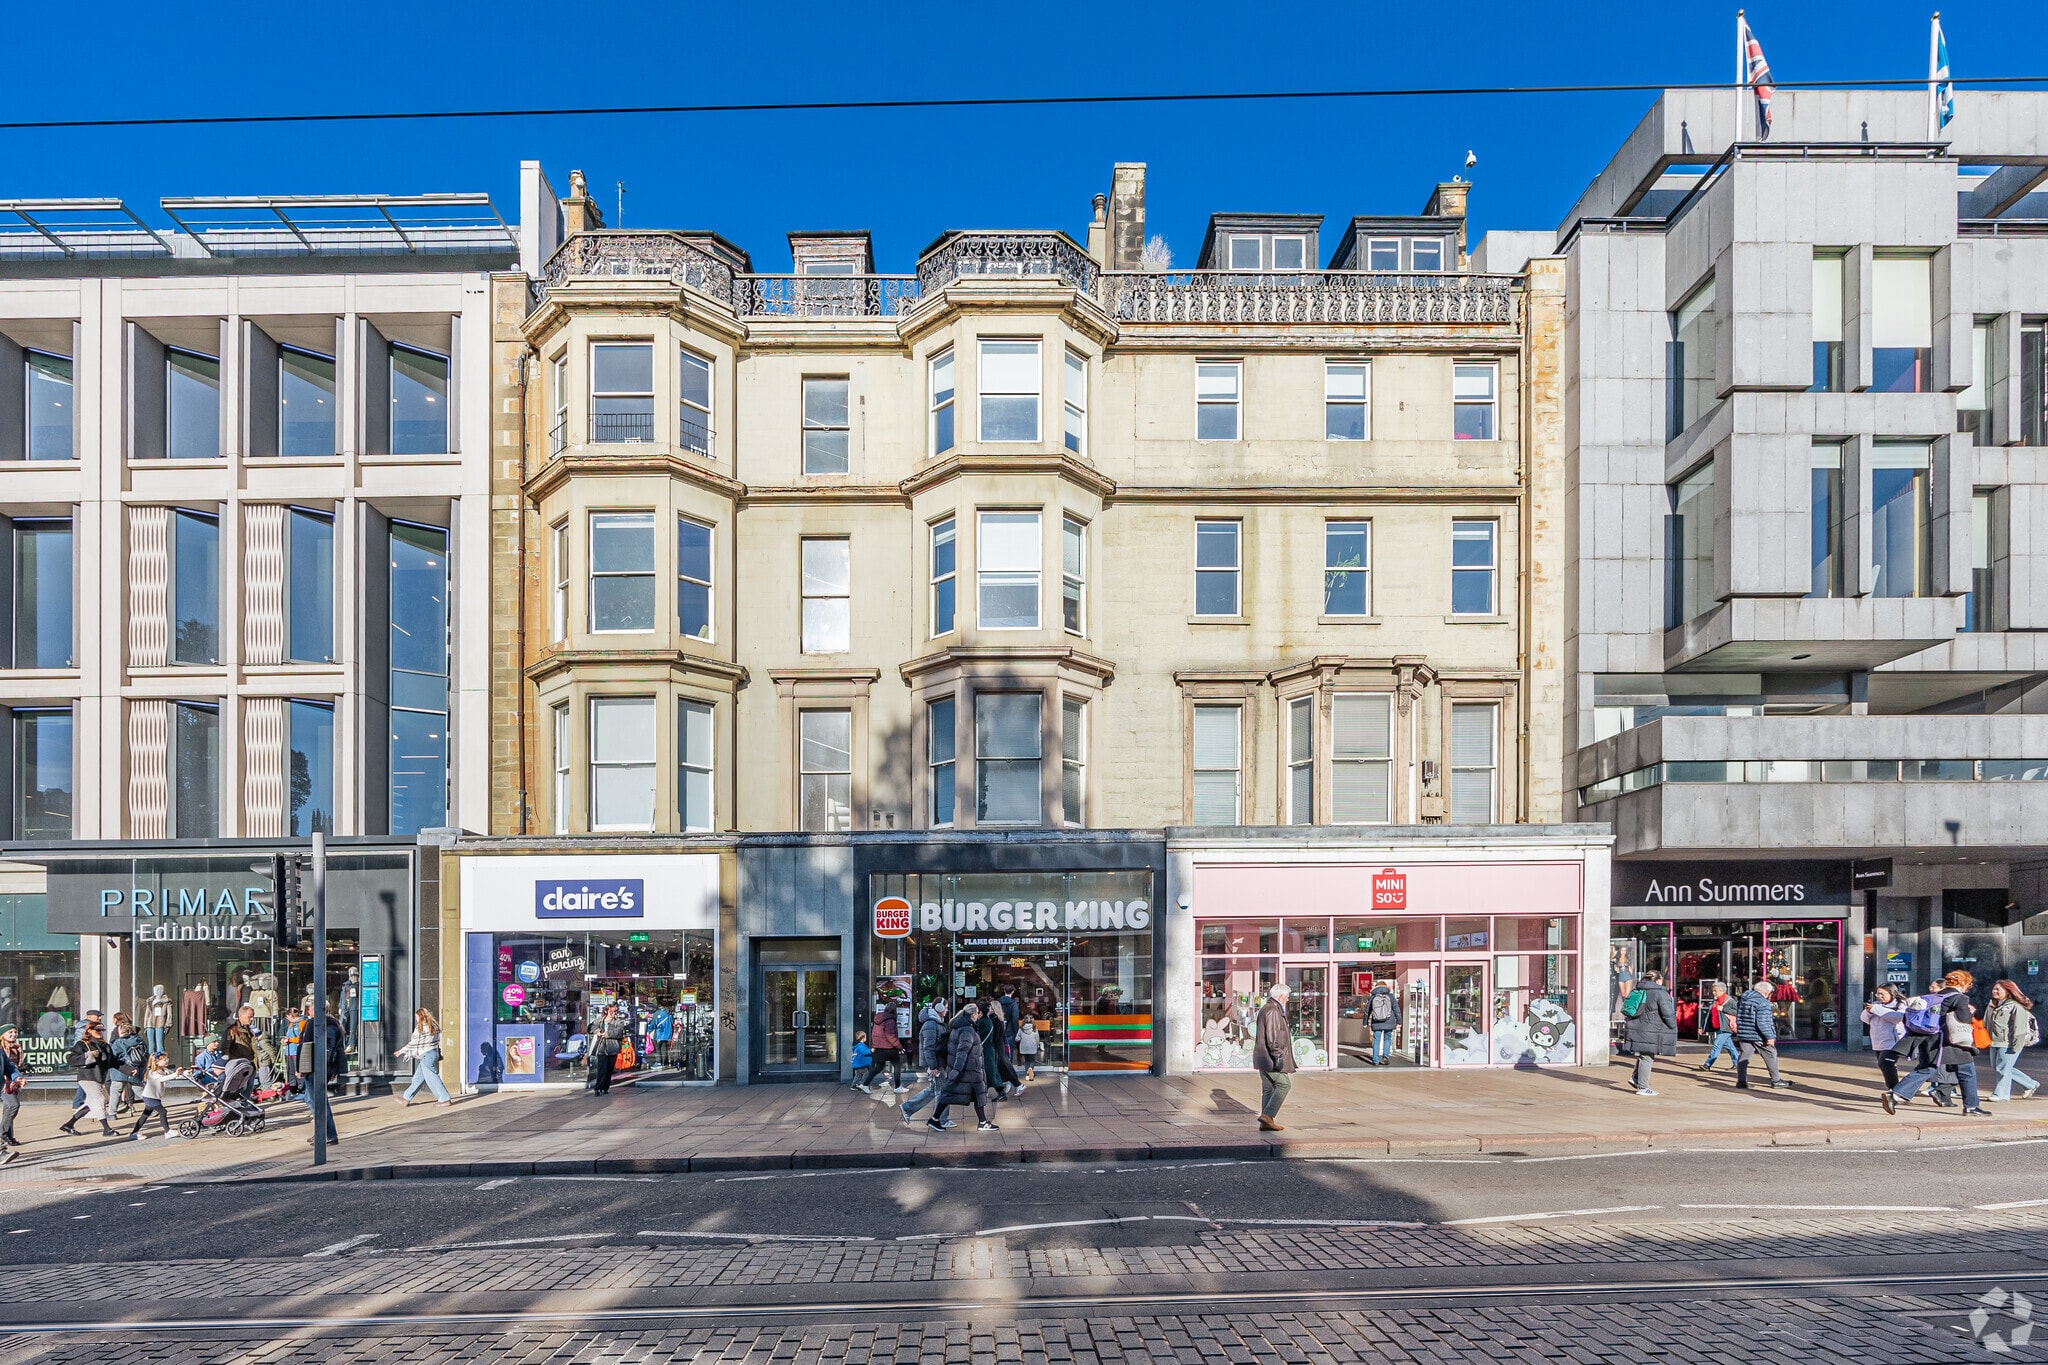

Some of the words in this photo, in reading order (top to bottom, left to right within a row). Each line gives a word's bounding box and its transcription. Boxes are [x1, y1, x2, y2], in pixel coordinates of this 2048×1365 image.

[1376, 879, 1404, 890] MINI
[1645, 879, 1692, 902] Ann
[1699, 878, 1805, 902] Summers
[101, 888, 268, 917] PRIMAR
[543, 886, 635, 911] claire's
[876, 910, 909, 918] BURGER
[920, 901, 1059, 931] BURGER
[1065, 900, 1150, 930] KING
[876, 918, 909, 929] KING
[1021, 937, 1042, 945] SINCE
[551, 948, 570, 960] ear
[543, 957, 586, 979] piercing
[17, 1037, 65, 1050] TUMN
